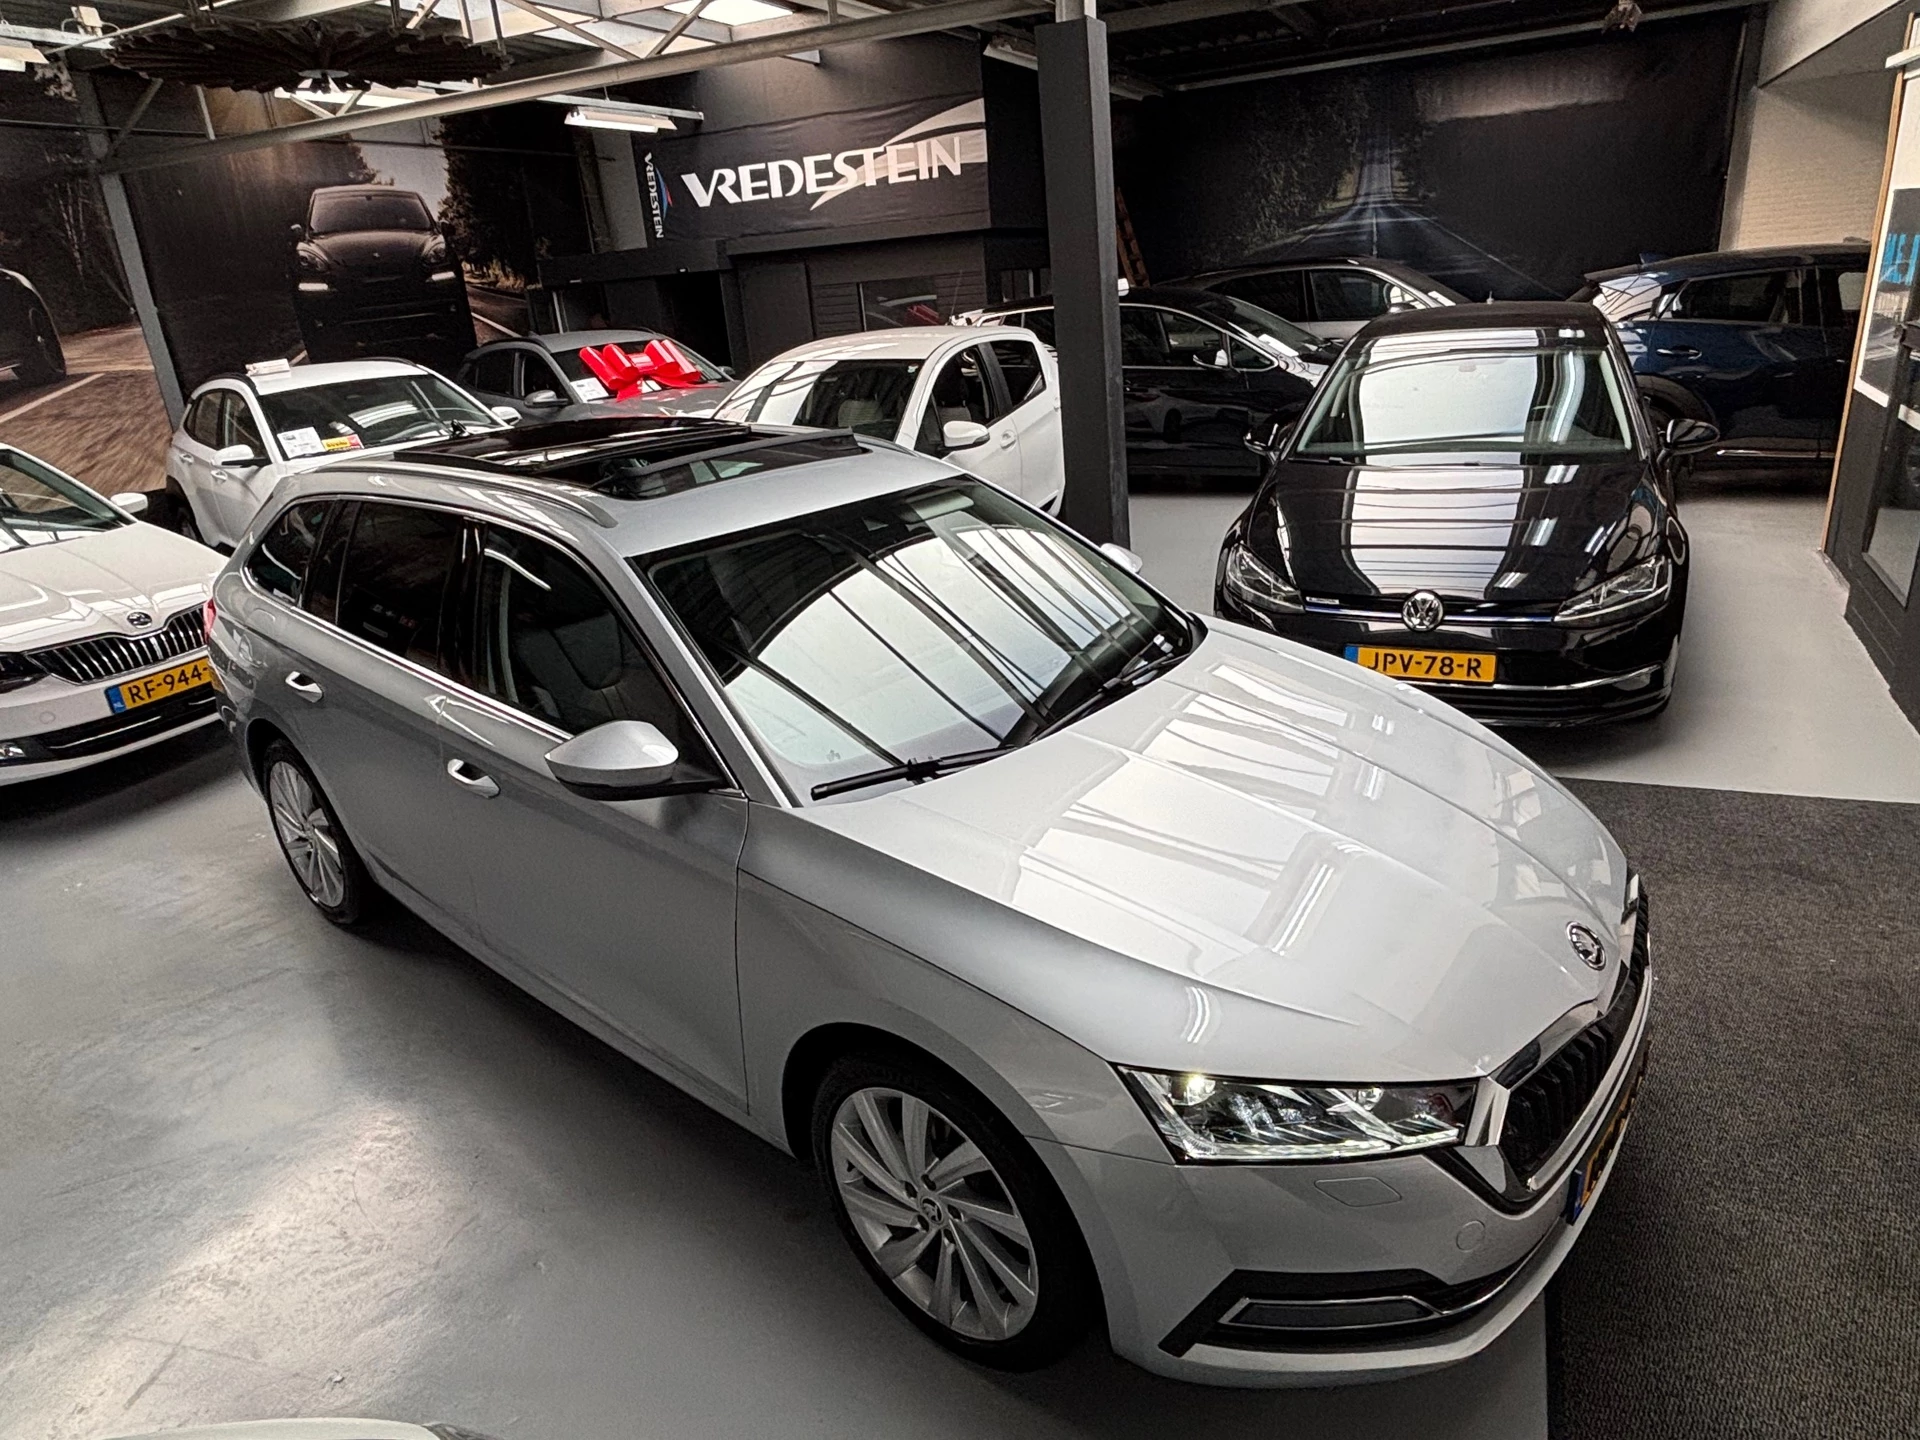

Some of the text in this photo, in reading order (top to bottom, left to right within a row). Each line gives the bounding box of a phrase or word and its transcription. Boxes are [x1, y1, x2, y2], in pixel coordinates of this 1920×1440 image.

[644, 151, 665, 239] VREDESTEIN
[681, 136, 962, 208] VREDESTEIN
[127, 664, 208, 704] RF-944-
[1367, 651, 1482, 679] JPV-78-R
